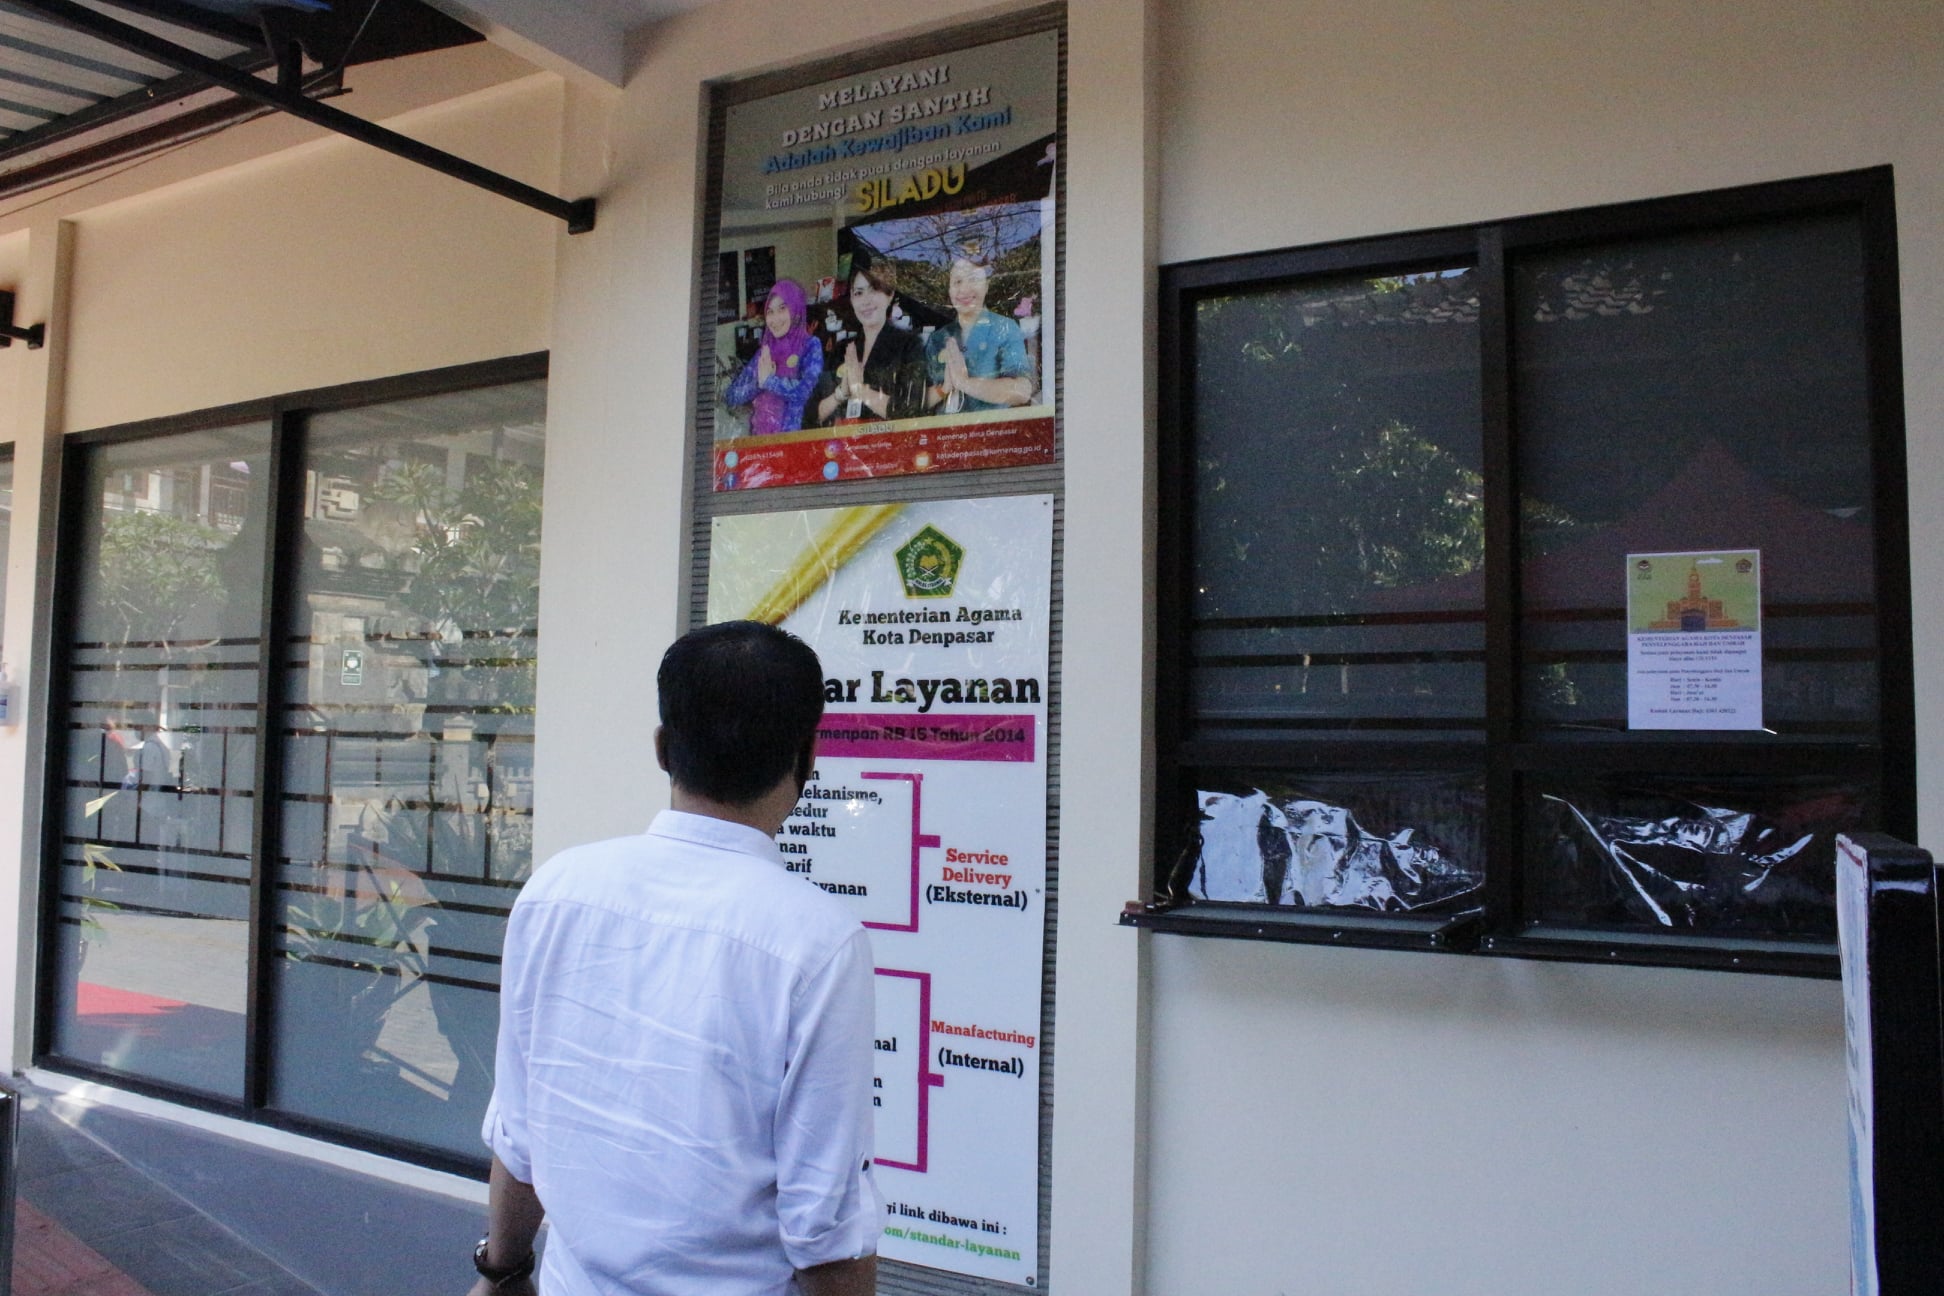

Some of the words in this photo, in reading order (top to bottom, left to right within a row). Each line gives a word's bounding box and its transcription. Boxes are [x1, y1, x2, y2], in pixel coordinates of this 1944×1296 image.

[818, 66, 951, 111] MELAYANI
[781, 110, 884, 147] DENGAN
[889, 87, 992, 125] SANTIH
[764, 145, 837, 175] Adalah
[841, 124, 949, 160] Kewajiban
[956, 107, 1013, 136] Kami
[766, 182, 790, 195] Bila
[792, 176, 822, 193] anda
[825, 168, 858, 186] tidak
[859, 164, 891, 181] puas
[893, 152, 943, 175] dengan
[945, 140, 1000, 164] layanan
[765, 194, 794, 210] kami
[796, 184, 847, 206] hubungi
[855, 162, 968, 213] SILADU
[838, 606, 951, 625] Kementerian
[955, 606, 1023, 626] Agama
[862, 629, 904, 645] Kota
[908, 629, 995, 648] Denpasar
[871, 670, 1041, 713] Layanan
[930, 727, 977, 742] Tahun
[984, 727, 1025, 742] 2014
[789, 822, 836, 837] waktu
[785, 858, 813, 873] arif
[946, 848, 1009, 866] Service
[942, 867, 1012, 889] Delivery
[926, 885, 1028, 911] (Eksternal)
[931, 1020, 1035, 1048] Manafacturing
[938, 1047, 1024, 1079] (Internal)
[900, 1203, 925, 1220] link
[928, 1209, 978, 1230] dibawa
[982, 1219, 999, 1234] ini
